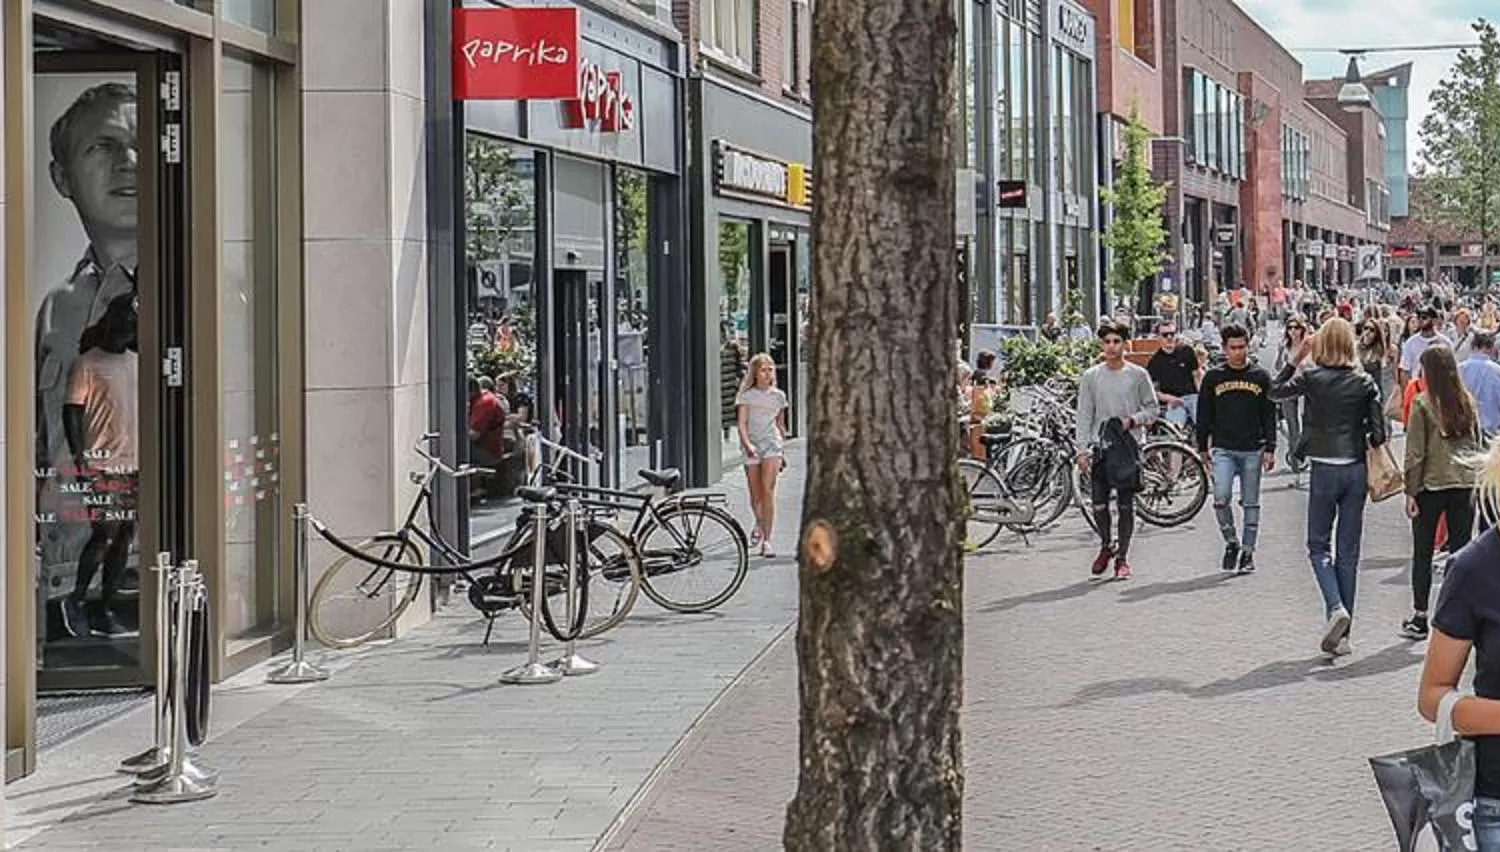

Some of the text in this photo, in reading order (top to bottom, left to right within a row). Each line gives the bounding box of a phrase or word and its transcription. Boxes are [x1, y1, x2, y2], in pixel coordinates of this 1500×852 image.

[83, 449, 112, 459] SALE
[33, 466, 57, 477] ALE
[60, 483, 92, 493] SALE
[83, 495, 114, 505] SALE
[33, 512, 57, 523] ALE
[105, 510, 136, 520] SALE
